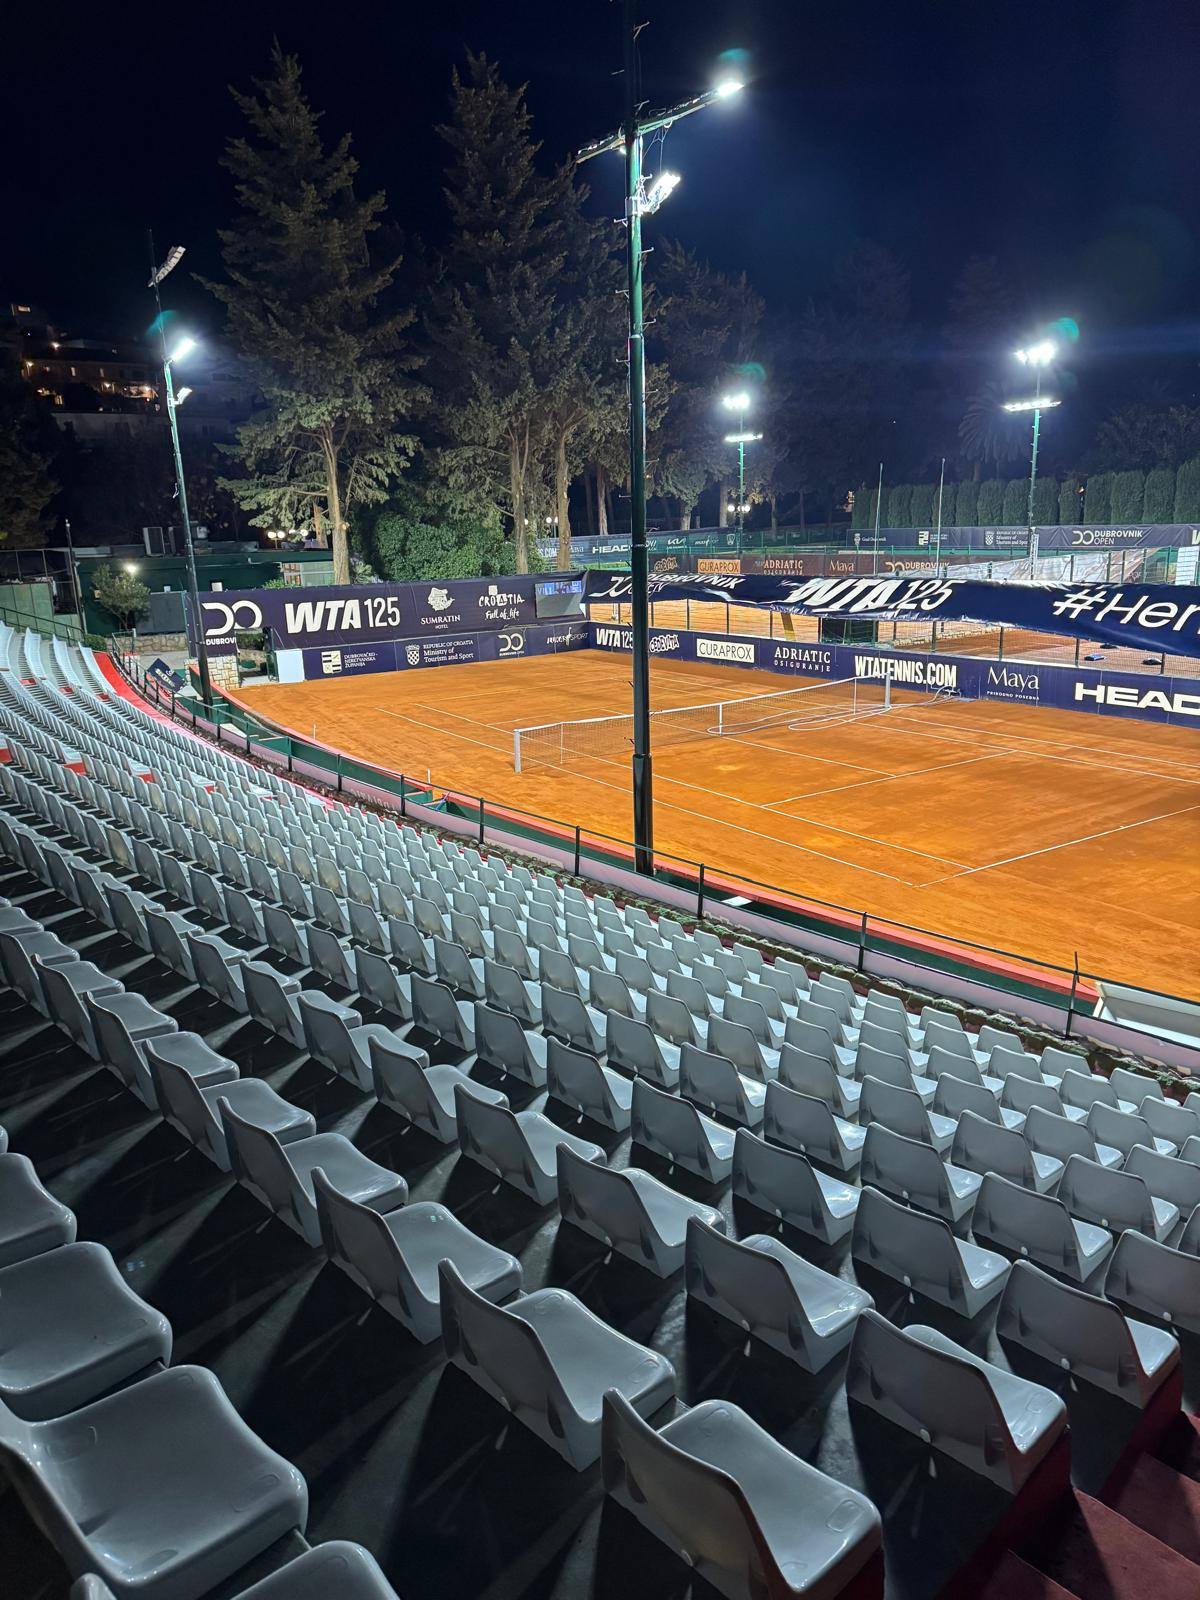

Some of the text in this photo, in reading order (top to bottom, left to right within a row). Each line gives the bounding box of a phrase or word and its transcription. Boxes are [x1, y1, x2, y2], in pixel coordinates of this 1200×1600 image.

[1094, 530, 1143, 538] DUBROVNIK
[1094, 537, 1115, 545] OPEN
[699, 561, 740, 573] CURAPROX
[763, 559, 803, 569] ADRIATIC
[829, 560, 855, 573] Maya
[478, 593, 526, 607] CROATIA
[784, 578, 968, 612] WTA 125
[285, 597, 401, 634] WTA 125
[1053, 588, 1200, 633] #Her
[420, 614, 461, 625] SUMRATIN
[596, 628, 621, 648] WTA
[650, 634, 680, 653] CEDEVITA
[423, 642, 446, 650] REPUBLIC
[423, 646, 455, 657] Ministry of
[699, 641, 752, 661] CURAPROX
[424, 655, 447, 663] Tourism
[459, 651, 475, 660] Sport
[774, 646, 831, 664] ADRIATIC
[774, 660, 831, 672] OSIGURANJE
[854, 655, 957, 688] WTATENNIS.COM
[987, 666, 1039, 692] Maya
[1074, 682, 1200, 717] HEAD
